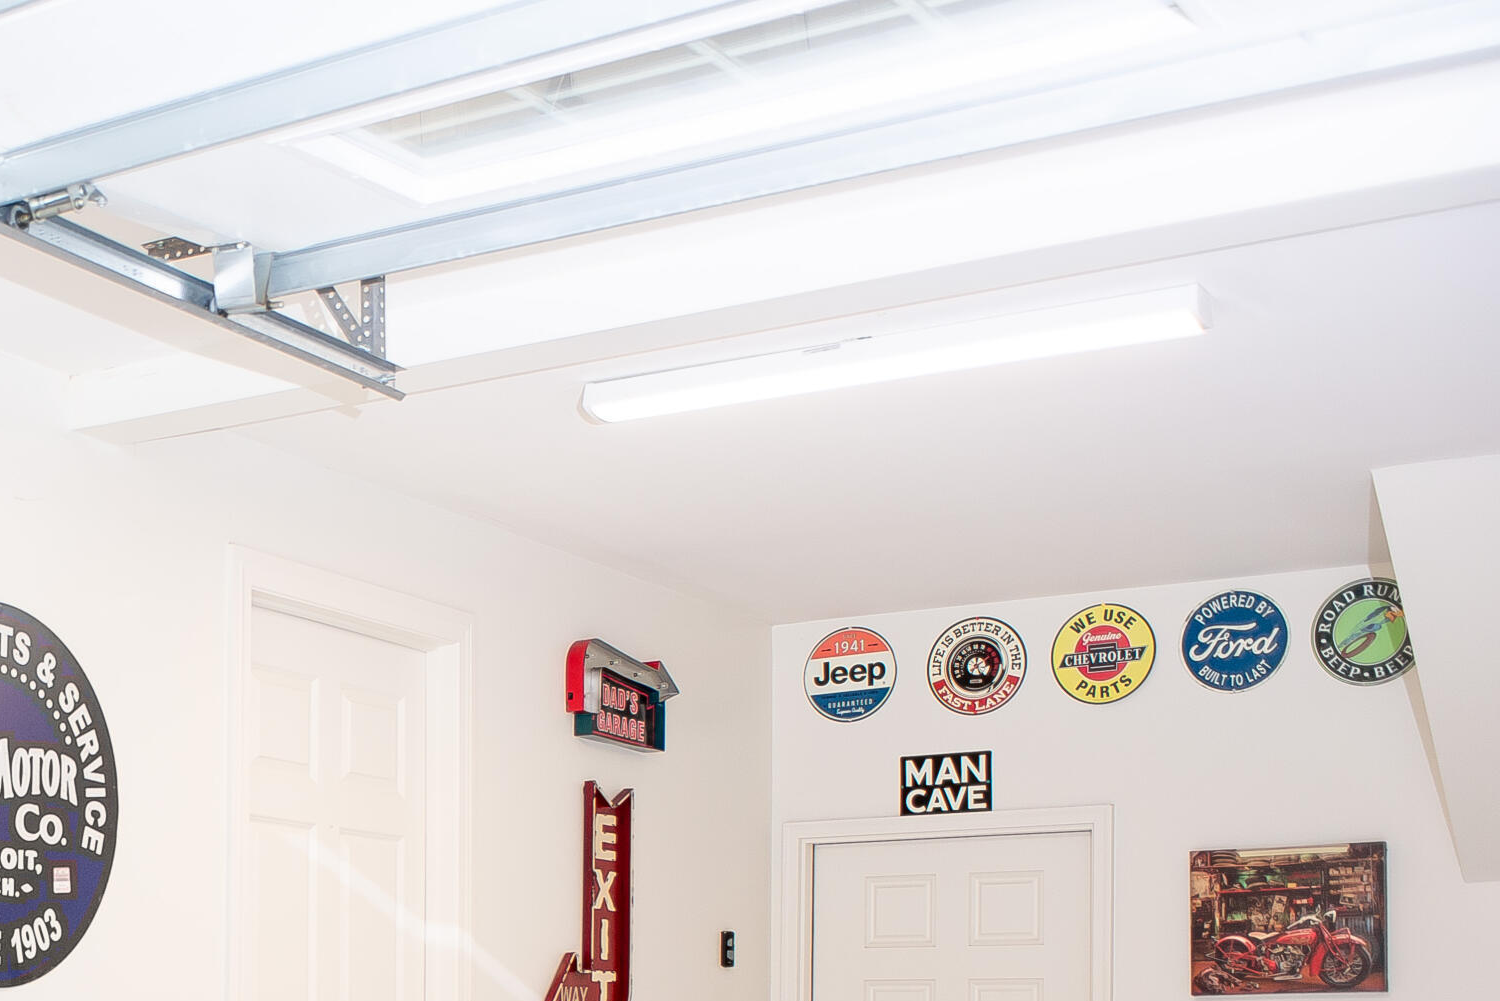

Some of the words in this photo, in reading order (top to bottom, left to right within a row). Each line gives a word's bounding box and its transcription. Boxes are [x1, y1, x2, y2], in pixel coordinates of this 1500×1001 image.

[1070, 611, 1097, 634] WE
[1103, 608, 1137, 630] USE
[1194, 594, 1255, 625] POWERED
[1254, 600, 1275, 618] BY
[1318, 590, 1356, 633] ROAD
[1362, 584, 1401, 601] RUN
[834, 639, 865, 655] 1941
[932, 648, 946, 677] LIFE
[941, 634, 955, 649] IS
[952, 621, 1002, 639] BETTER
[1000, 631, 1015, 646] IN
[1009, 644, 1022, 671] THE
[1082, 631, 1122, 646] Genuine
[1188, 622, 1280, 662] Ford
[1064, 647, 1142, 667] CHEVROLET
[1198, 665, 1228, 687] BUILT
[1229, 674, 1244, 687] TO
[1245, 658, 1273, 683] LAST
[1320, 646, 1361, 679] BEEP
[1373, 644, 1414, 678] BEEP
[813, 661, 887, 687] Jeep
[1075, 674, 1133, 698] PARTS
[602, 683, 639, 715] DAD'S
[938, 685, 972, 710] FAST
[974, 680, 1015, 711] LANE
[597, 709, 645, 742] GARAGE
[36, 651, 58, 689] &
[57, 682, 107, 856] SERVICE
[905, 754, 988, 788] MAN
[905, 784, 987, 815] CAVE
[10, 908, 63, 964] 1903
